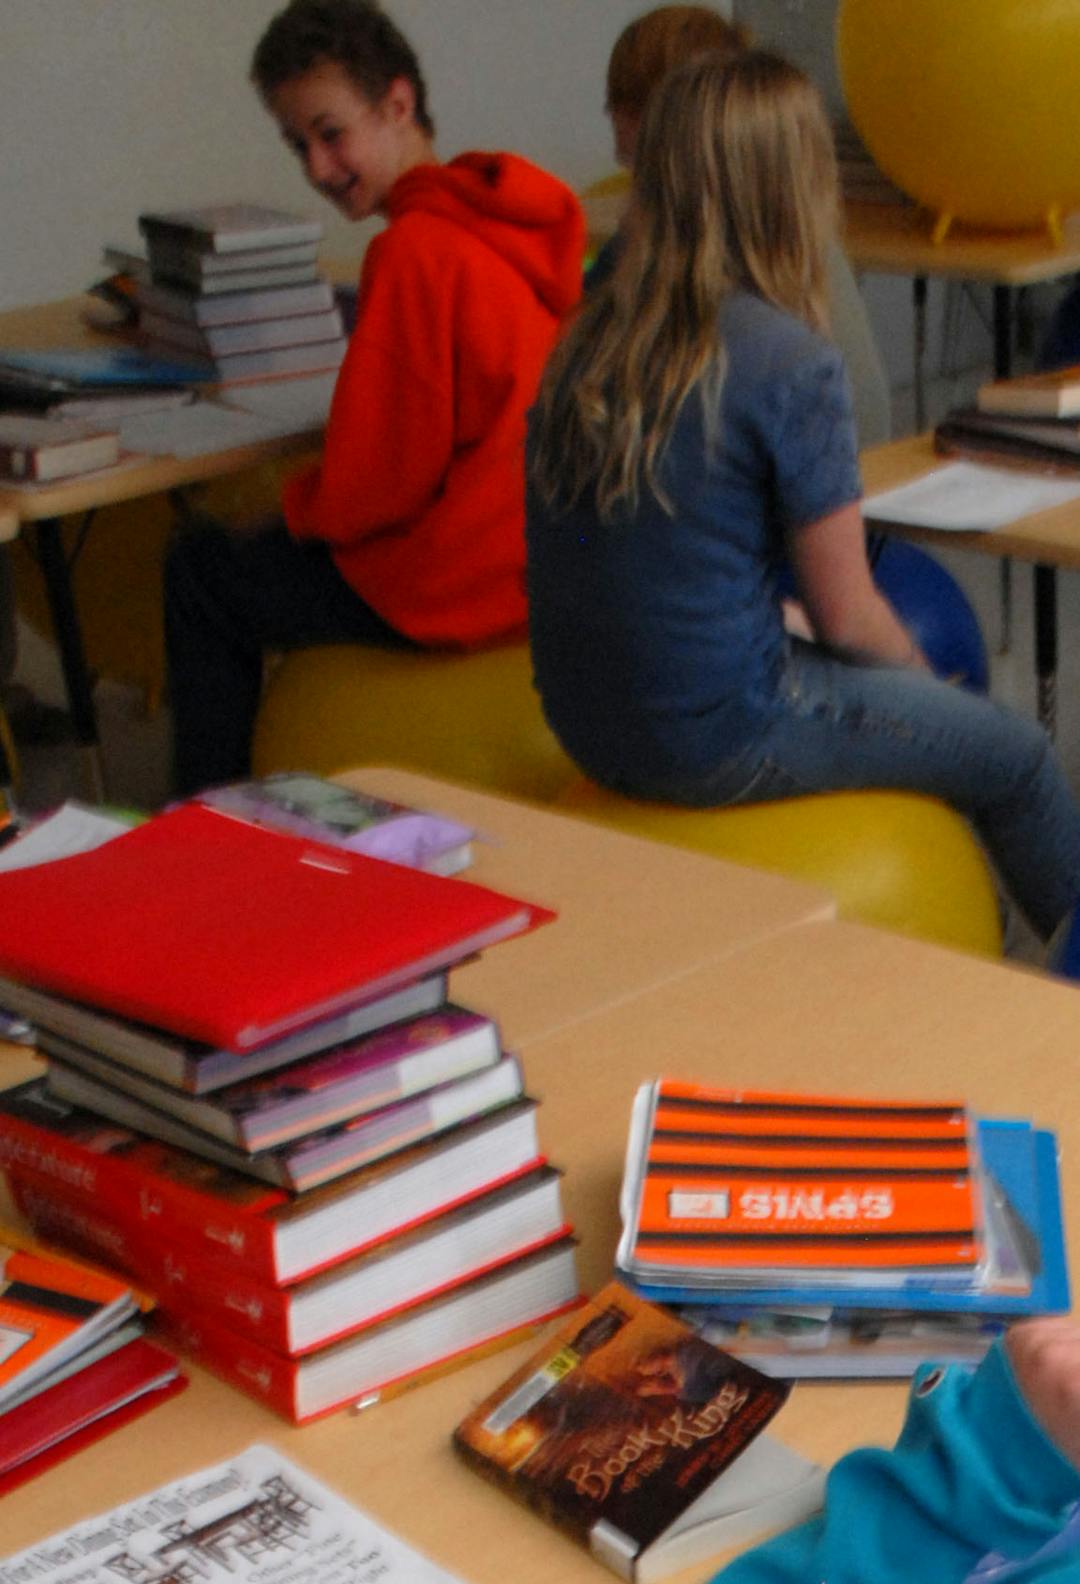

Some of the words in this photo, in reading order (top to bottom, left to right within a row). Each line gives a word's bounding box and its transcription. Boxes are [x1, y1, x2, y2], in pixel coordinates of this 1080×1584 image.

[566, 1426, 669, 1500] Book
[659, 1381, 750, 1449] King
[341, 1549, 384, 1571] Too
